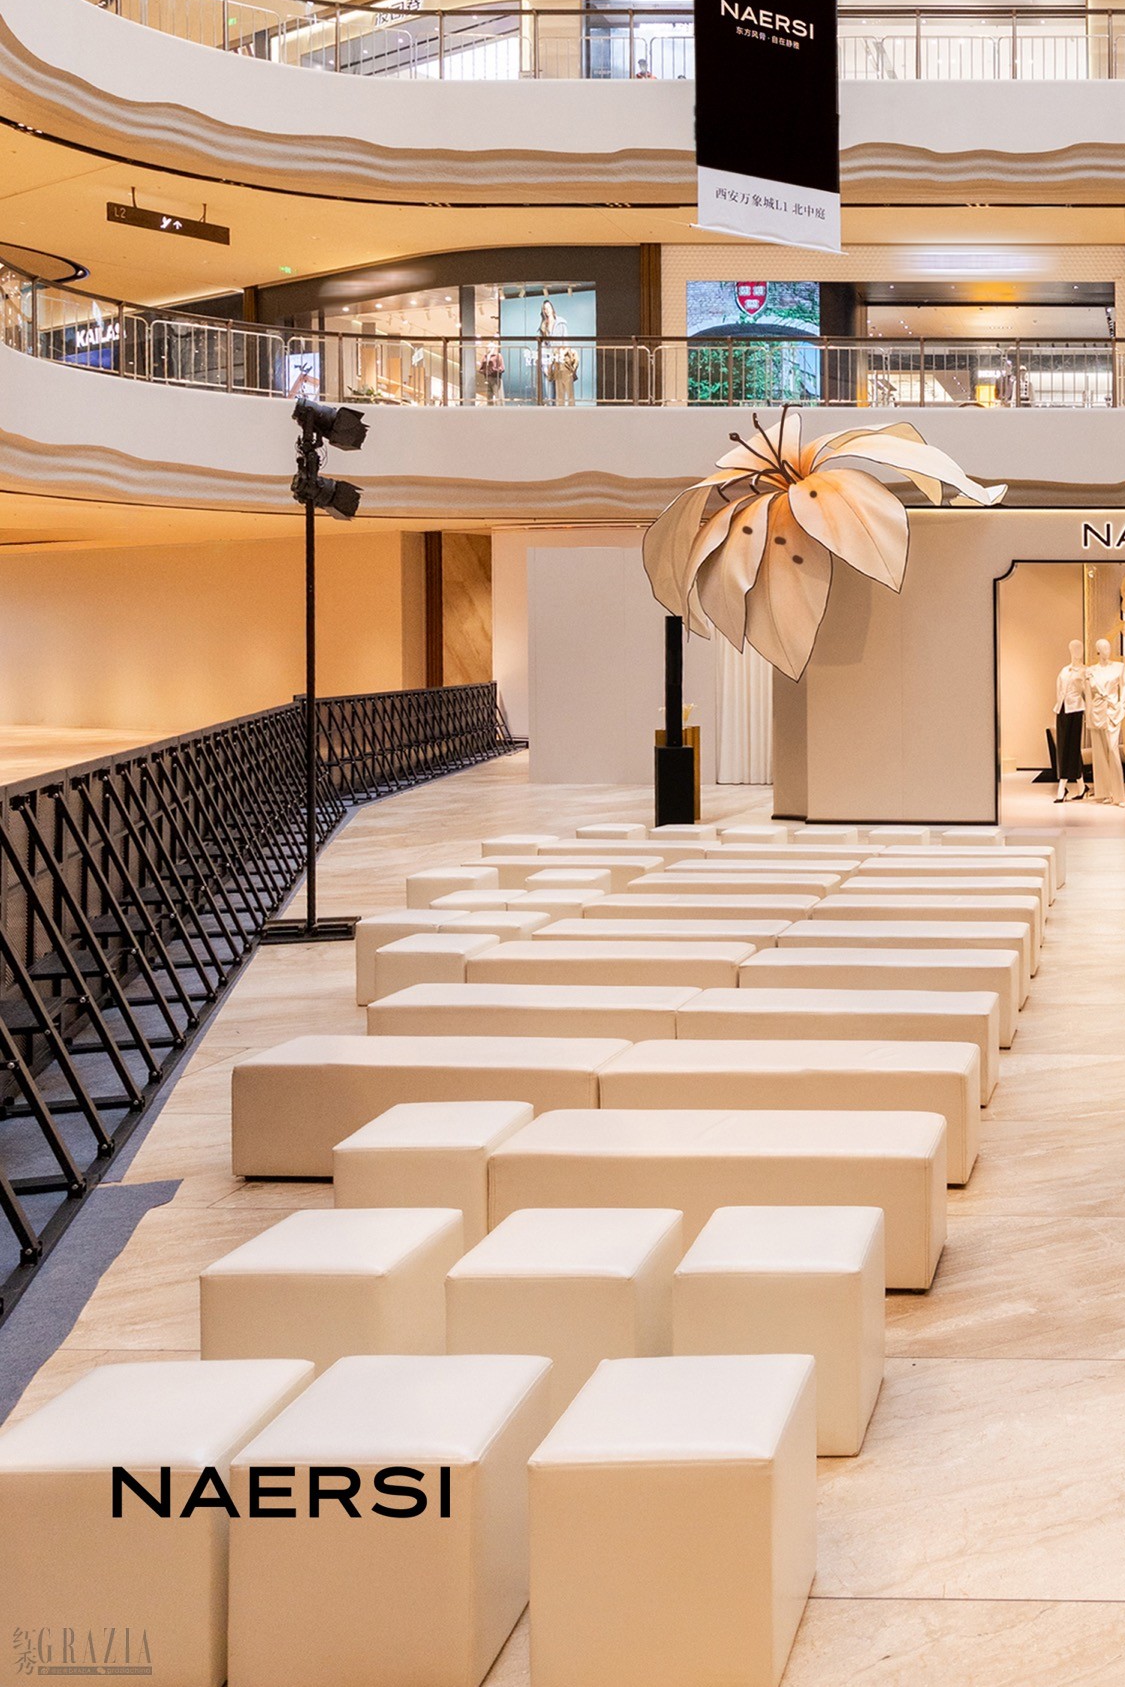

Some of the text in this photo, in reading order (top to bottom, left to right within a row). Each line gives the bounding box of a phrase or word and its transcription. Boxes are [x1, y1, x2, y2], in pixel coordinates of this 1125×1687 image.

[721, 0, 814, 40] NAERSI
[114, 207, 126, 219] L2
[715, 187, 826, 220] 西安万象城L1 北中庭
